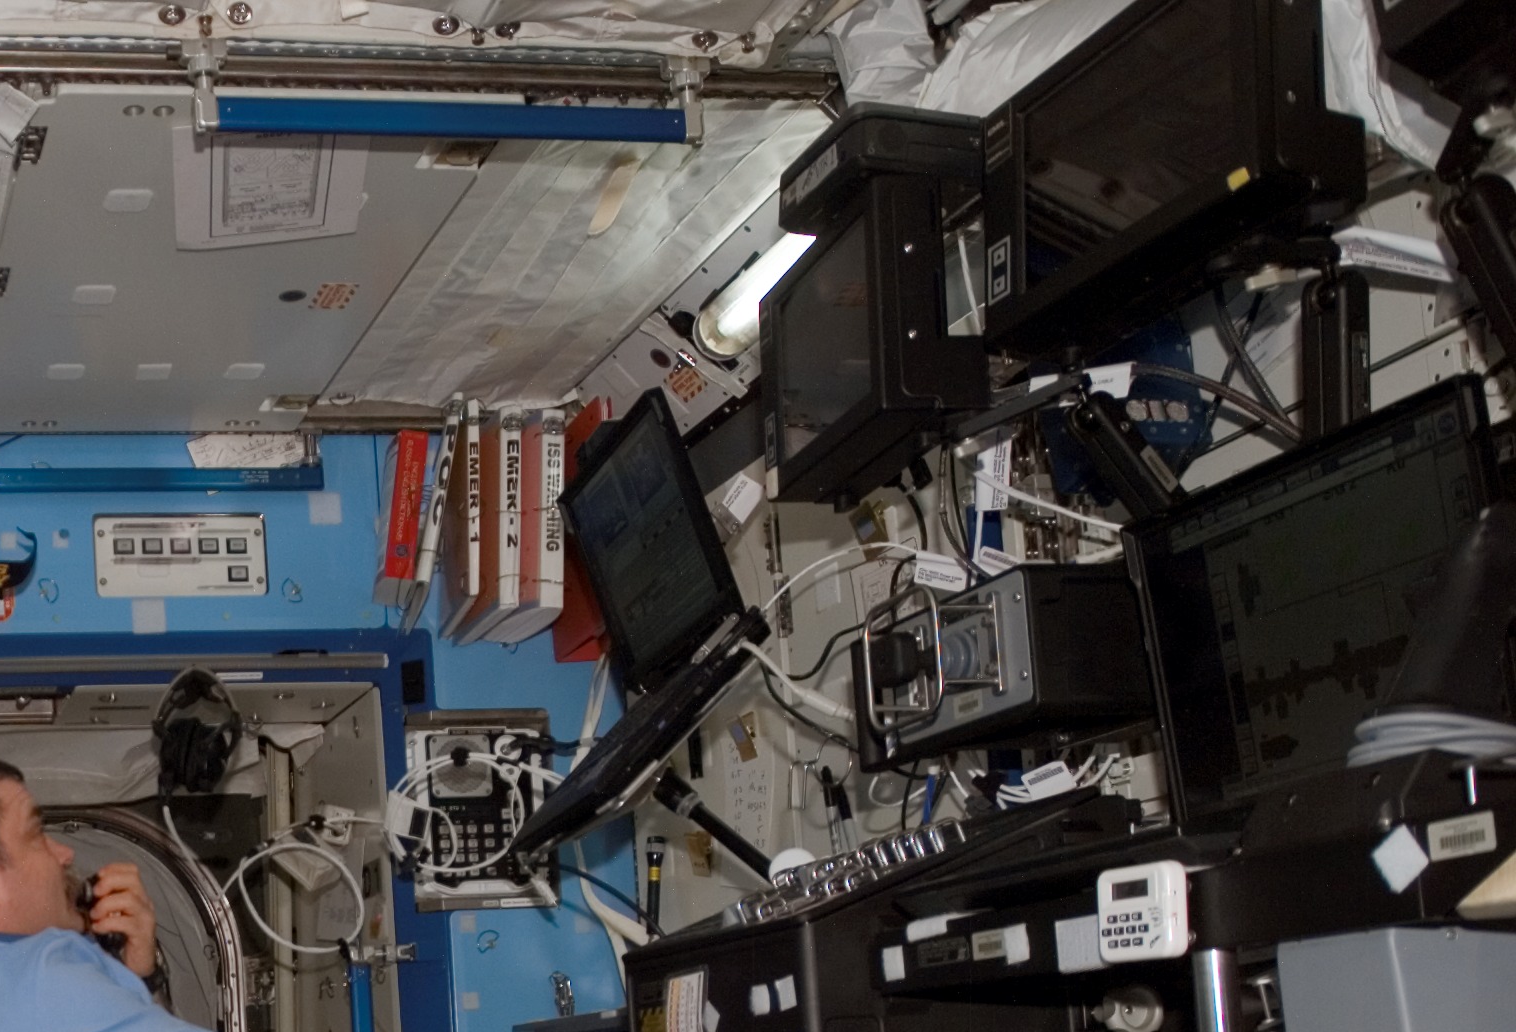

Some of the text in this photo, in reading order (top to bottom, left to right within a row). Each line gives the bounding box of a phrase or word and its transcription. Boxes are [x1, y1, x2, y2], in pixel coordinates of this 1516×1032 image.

[547, 442, 561, 469] ISS
[469, 442, 479, 509] EMER
[470, 533, 479, 542] 1
[507, 533, 518, 548] 2
